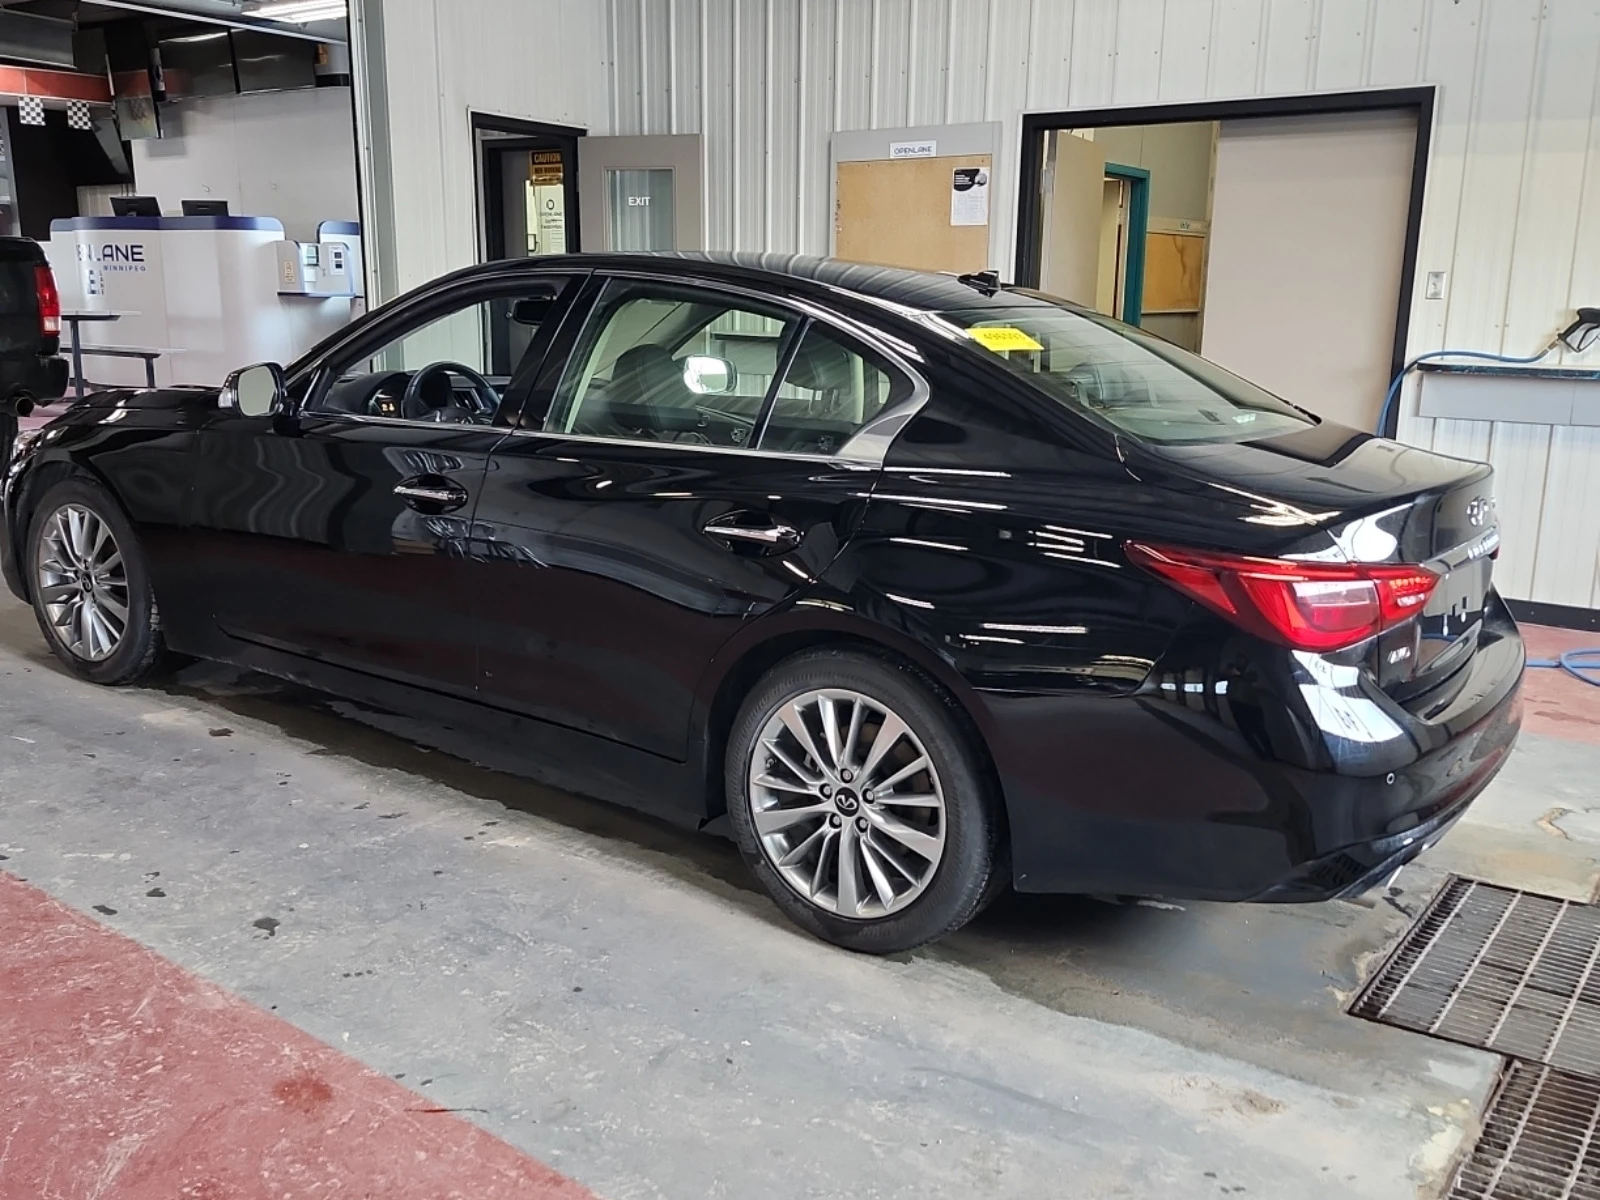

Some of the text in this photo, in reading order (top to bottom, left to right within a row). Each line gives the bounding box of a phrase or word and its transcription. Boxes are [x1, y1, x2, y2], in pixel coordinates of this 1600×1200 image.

[534, 152, 561, 163] CAUTION
[628, 196, 651, 206] EXIT
[103, 264, 146, 272] WINNIPEG
